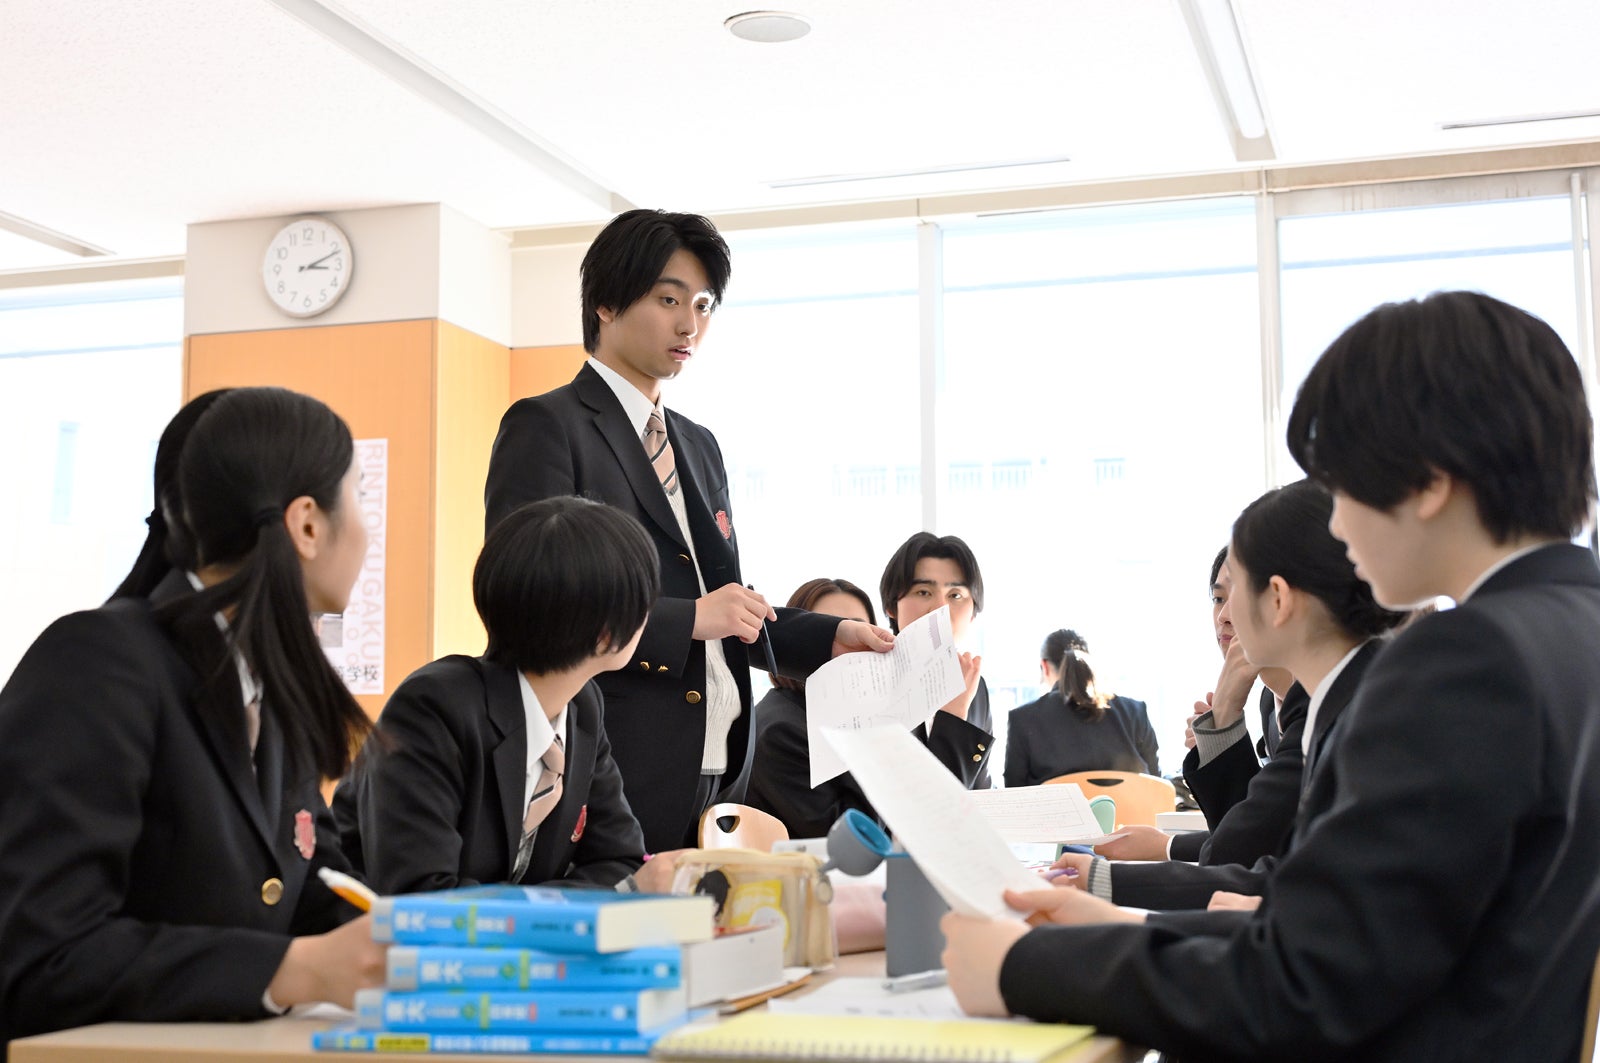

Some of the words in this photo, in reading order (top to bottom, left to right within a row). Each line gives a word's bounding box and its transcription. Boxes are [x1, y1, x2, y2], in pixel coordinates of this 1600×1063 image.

[289, 233, 296, 246] 11
[302, 227, 313, 241] 12
[277, 246, 288, 260] 10
[273, 263, 282, 276] 9
[334, 257, 342, 271] 3
[277, 281, 285, 294] 8
[330, 276, 338, 288] 4
[290, 291, 298, 304] 7
[303, 295, 312, 308] 6
[319, 289, 327, 302] 5
